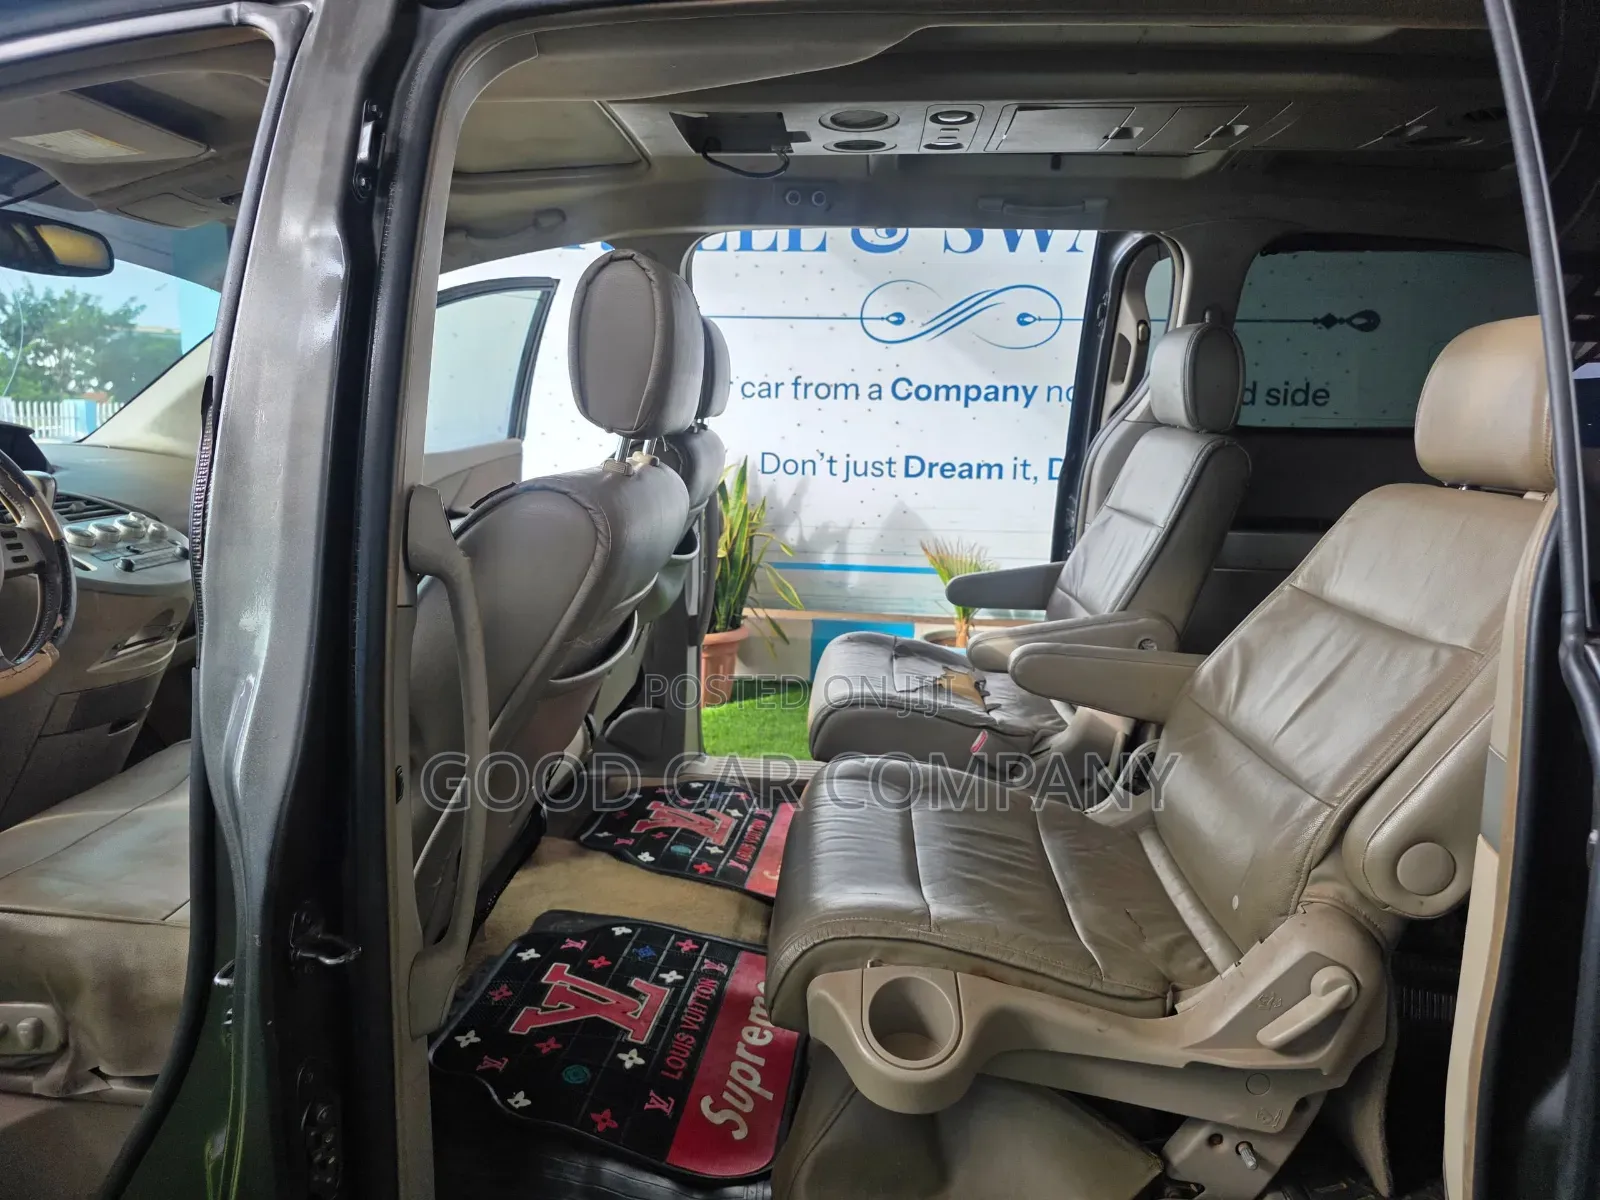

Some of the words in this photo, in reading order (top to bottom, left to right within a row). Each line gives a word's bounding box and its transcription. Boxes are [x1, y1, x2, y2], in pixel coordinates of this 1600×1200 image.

[740, 380, 785, 399] car
[791, 375, 859, 400] from
[867, 382, 882, 401] a
[891, 376, 1039, 409] Company
[1265, 379, 1330, 407] side
[761, 450, 837, 476] Don't
[842, 453, 897, 483] just
[904, 455, 1003, 480] Dream
[1012, 457, 1038, 484] it,
[661, 1032, 697, 1080] LOUIS
[679, 976, 720, 1031] VUITTON
